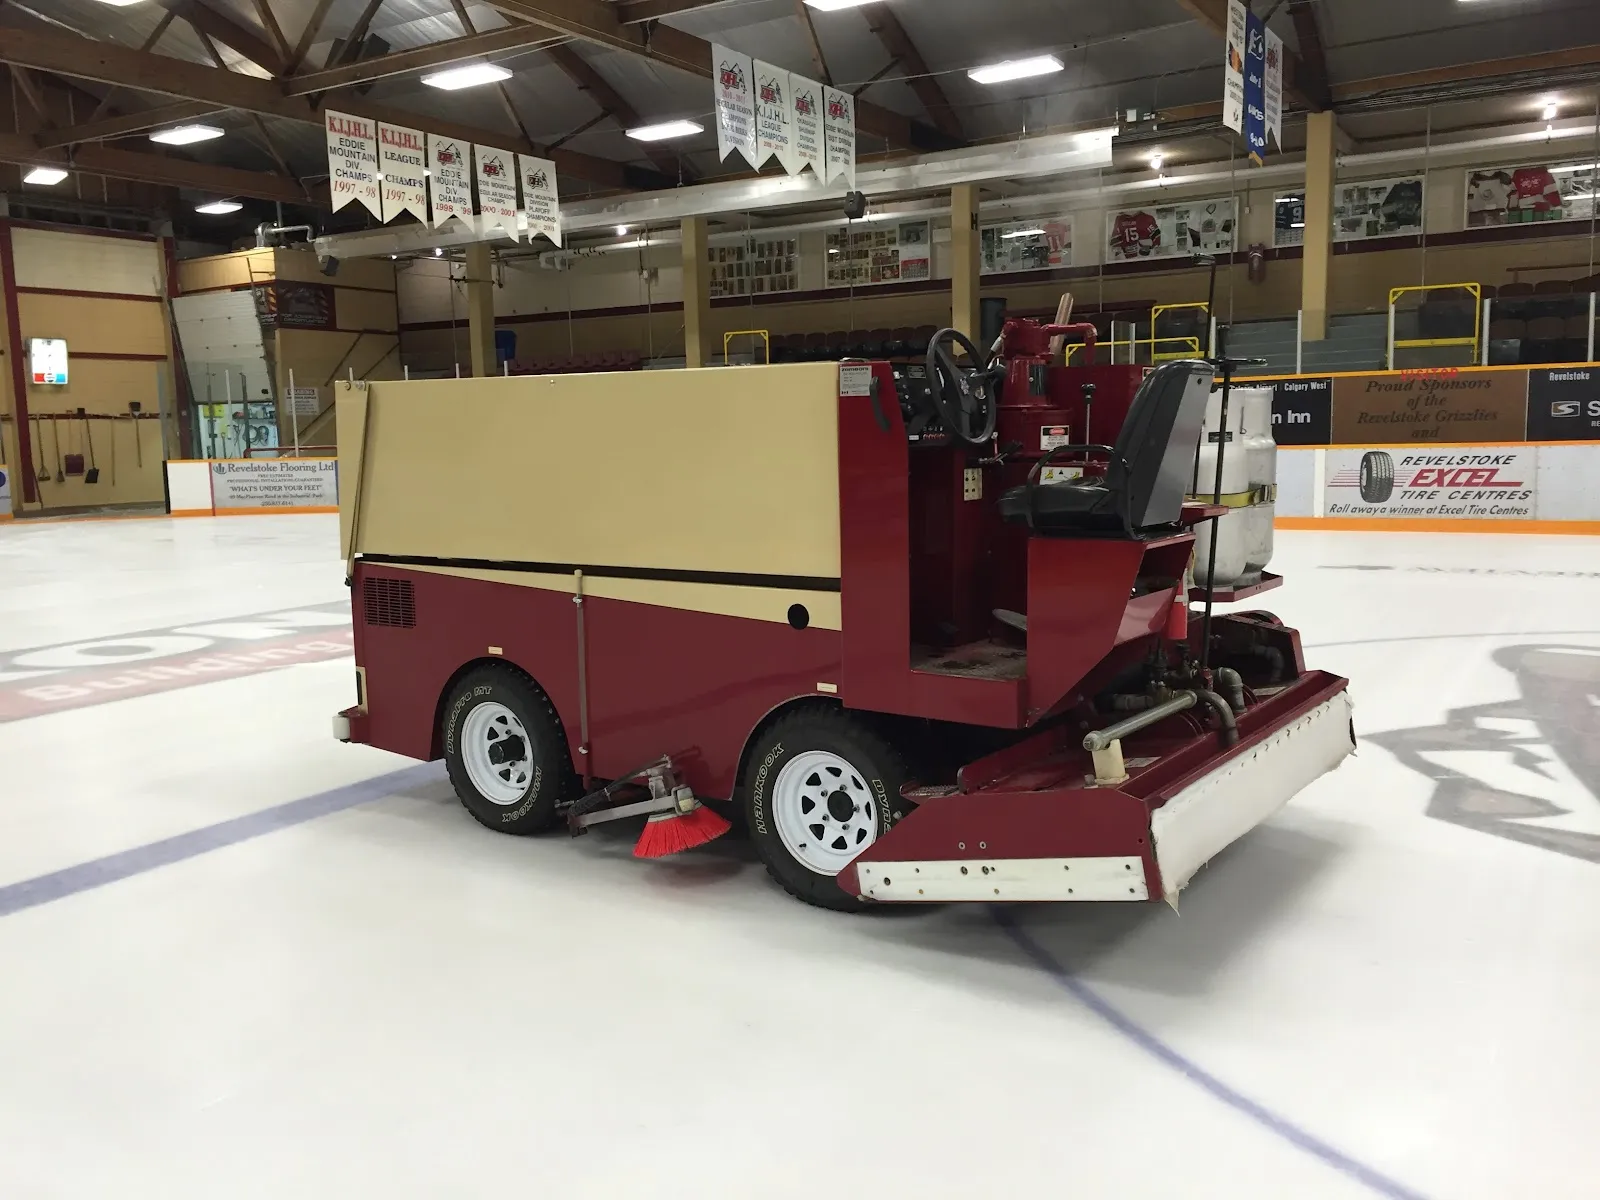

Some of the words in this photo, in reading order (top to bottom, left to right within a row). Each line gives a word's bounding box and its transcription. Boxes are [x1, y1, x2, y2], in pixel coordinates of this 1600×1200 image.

[762, 121, 781, 132] LEAGUE
[758, 129, 788, 144] CHAMPIONS
[339, 138, 366, 150] EDDIE
[329, 146, 375, 163] MOUNTAIN
[384, 151, 420, 165] LEAGUE
[345, 160, 362, 170] DIV.
[336, 168, 372, 182] CHAMPS
[441, 169, 461, 180] EDDIE
[385, 174, 423, 188] CHAMPS
[434, 176, 469, 189] MOUNTAIN
[491, 181, 516, 191] MOUNTAIN
[334, 181, 356, 194] 1997
[366, 186, 376, 198] 98
[386, 189, 405, 202] 1997
[416, 194, 425, 206] 98
[439, 194, 467, 206] CHAMPS
[529, 198, 549, 207] DIVISION
[436, 203, 453, 212] 1998
[528, 205, 550, 214] PLAYOFF
[526, 213, 556, 222] CHAMPIONS
[1125, 228, 1139, 242] 15
[1401, 368, 1459, 381] VISITOR
[1550, 371, 1590, 381] Revelstoke
[1284, 383, 1308, 392] Calgary
[1365, 379, 1414, 392] Proud
[1419, 378, 1492, 394] Sponsors
[1407, 396, 1420, 410] of
[1425, 394, 1447, 406] the
[1287, 410, 1311, 423] Inn
[1357, 410, 1430, 424] Revelstoke
[1436, 409, 1498, 422] Grizzlies
[1412, 426, 1440, 438] and
[1400, 455, 1516, 466] REVELSTOKE
[228, 463, 277, 473] Revelstoke
[280, 463, 316, 473] Flooring
[319, 462, 334, 471] Ltd
[1408, 468, 1524, 487] EXCEL
[1401, 490, 1440, 499] TIRE
[1448, 490, 1532, 500] CENTRES
[1329, 504, 1349, 513] Roll
[1351, 506, 1379, 516] away
[1390, 506, 1424, 514] winner
[1427, 506, 1438, 514] at
[1439, 505, 1465, 514] Excel
[1468, 505, 1487, 515] Tire
[1490, 506, 1529, 515] Centres
[19, 639, 351, 701] Building
[474, 686, 492, 696] MT
